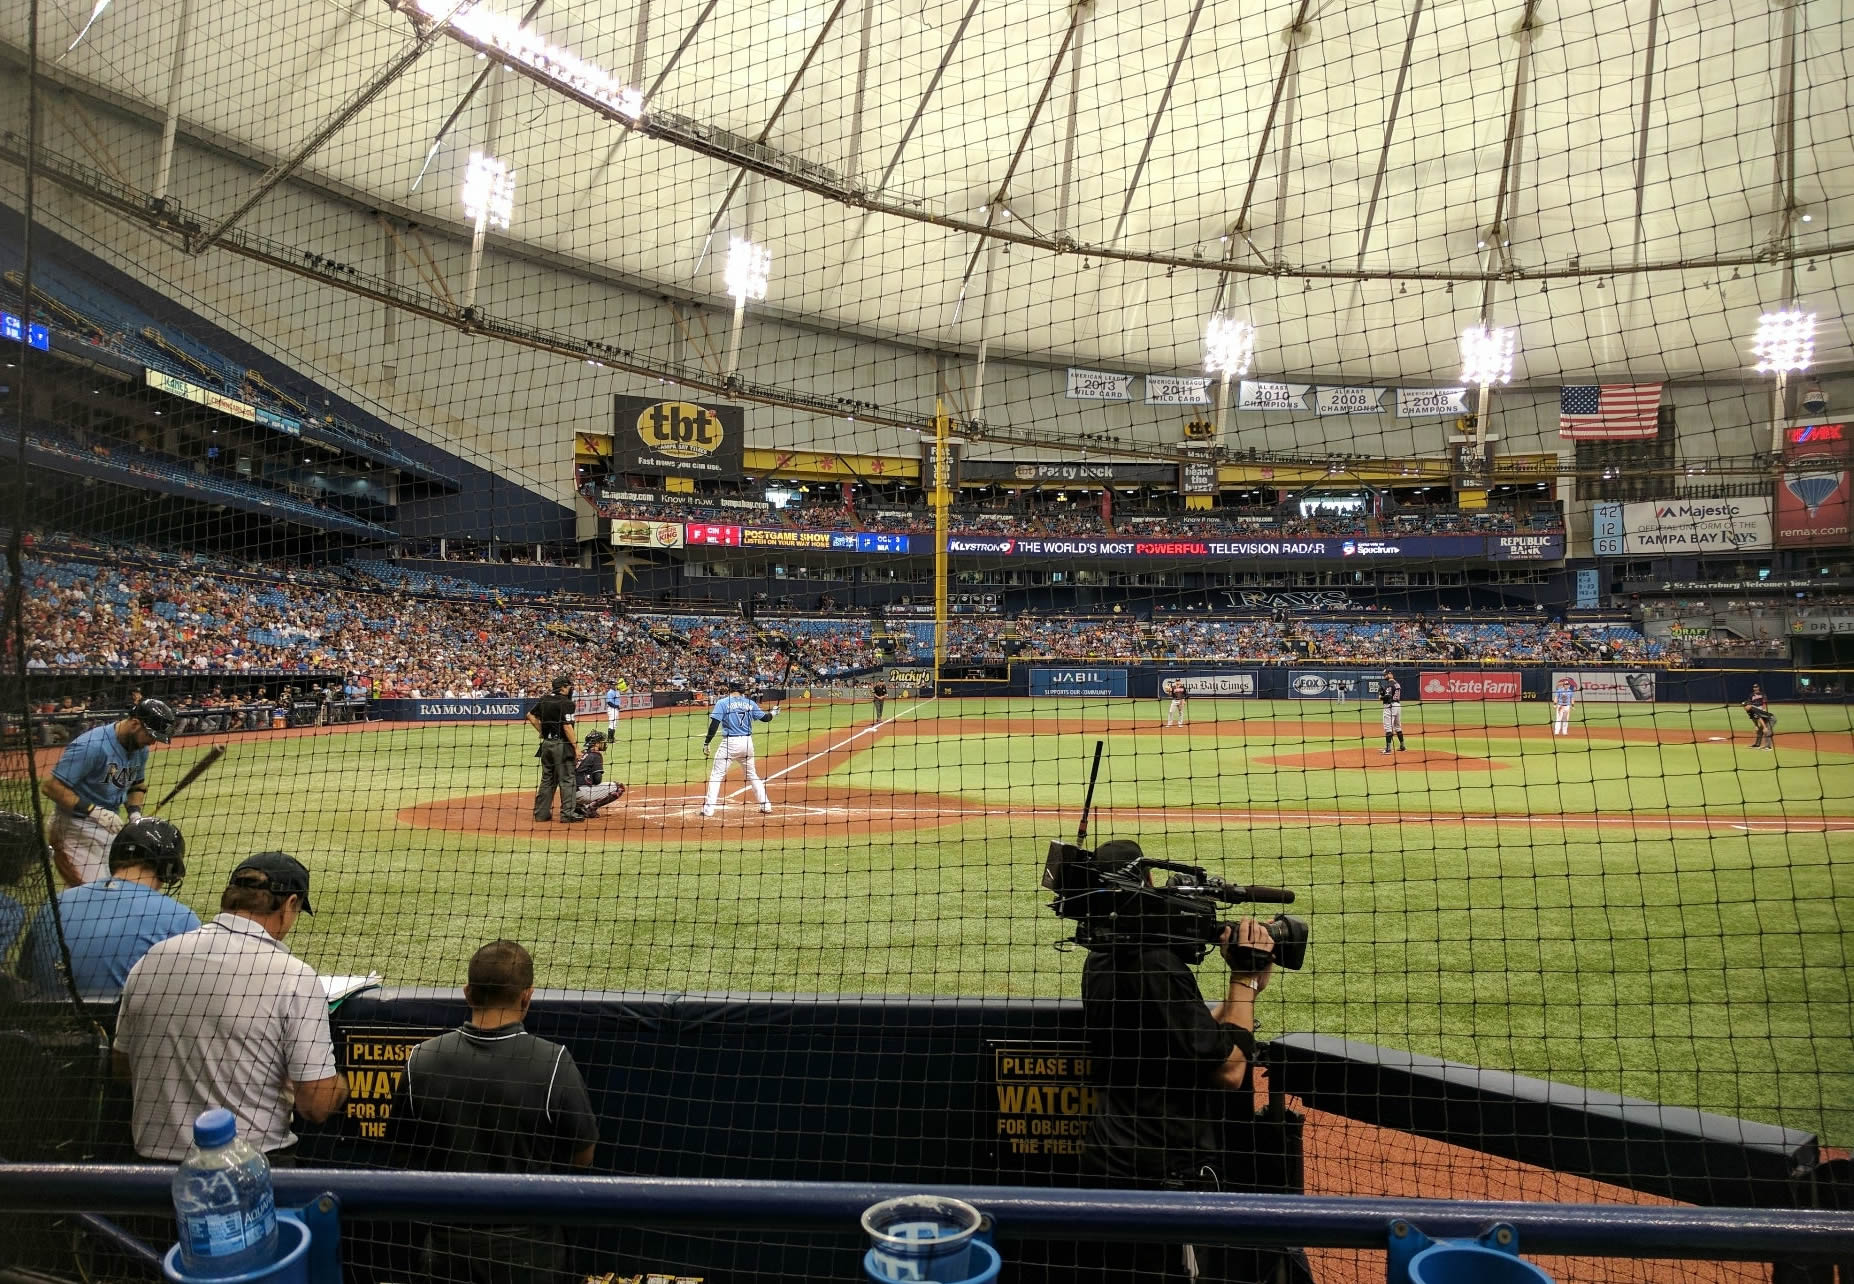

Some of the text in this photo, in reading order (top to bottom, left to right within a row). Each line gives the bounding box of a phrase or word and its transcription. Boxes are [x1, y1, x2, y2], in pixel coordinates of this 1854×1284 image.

[1084, 380, 1116, 391] 2013
[1162, 385, 1194, 396] 2011
[1074, 389, 1123, 398] WILD CARD
[1177, 395, 1201, 403] CARD
[1256, 390, 1290, 401] 2010
[1244, 400, 1299, 409] CHAMPIONS
[1331, 395, 1367, 405] 2008
[1413, 397, 1449, 407] 2008
[1402, 406, 1459, 415] CHAMPIONS
[650, 405, 712, 444] tbt
[638, 457, 655, 465] Fast
[1184, 467, 1214, 476] heard
[1191, 475, 1208, 484] the
[602, 490, 654, 502] tampabay.com
[661, 494, 686, 504] Know
[694, 498, 714, 506] now.
[721, 499, 769, 510] tampabay.com
[1600, 506, 1617, 518] 42
[1679, 505, 1740, 519] Majestic
[1602, 522, 1615, 535] 12
[1739, 521, 1757, 529] THE
[658, 532, 677, 541] KING
[694, 530, 701, 539] F
[744, 529, 798, 541] POSTGAME
[799, 534, 830, 543] SHOW
[1780, 525, 1848, 537] remax.com
[1500, 537, 1551, 546] REPUBLIC
[1638, 530, 1758, 546] TAMPA BAY RAYS
[1018, 542, 1040, 553] THE
[1043, 542, 1097, 554] WORLD'S
[1100, 543, 1134, 554] MOST
[1136, 543, 1208, 554] POWERFUL
[1209, 543, 1279, 554] TELEVISION
[1283, 543, 1325, 554] RADAR
[1357, 546, 1397, 556] Spectrum
[1510, 546, 1541, 555] BANK
[1600, 540, 1617, 552] 66
[889, 669, 931, 685] Ducky's
[1053, 672, 1104, 683] JABIL
[1200, 680, 1219, 693] Bay
[1221, 679, 1249, 690] Times
[1300, 679, 1319, 688] FOX
[1582, 681, 1626, 691] TOTAL
[1522, 691, 1537, 699] 370
[420, 704, 520, 715] RAYMOND JAMES
[736, 711, 746, 727] 7
[1003, 1058, 1067, 1075] PLEASE
[997, 1086, 1098, 1116] WATCH
[348, 1103, 376, 1118] FOR
[360, 1122, 387, 1137] THE
[997, 1119, 1094, 1136] FOR OBJECT
[1010, 1139, 1038, 1154] THE
